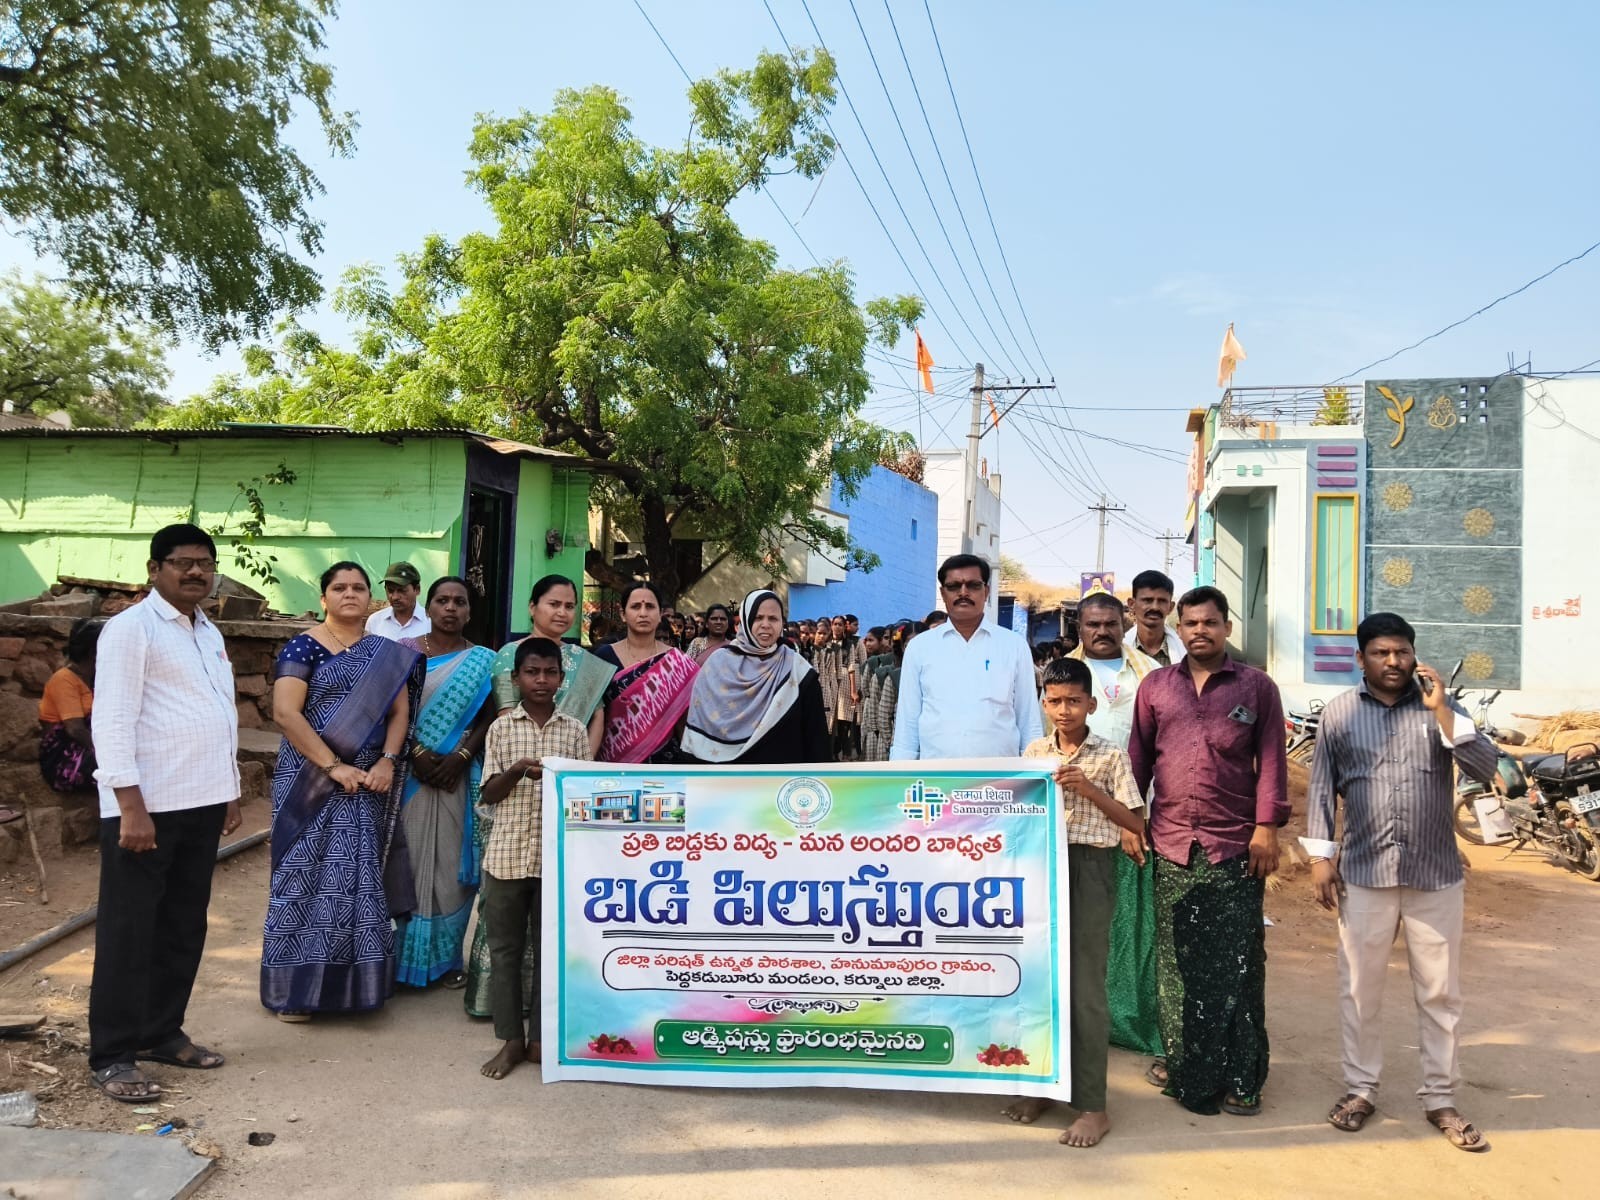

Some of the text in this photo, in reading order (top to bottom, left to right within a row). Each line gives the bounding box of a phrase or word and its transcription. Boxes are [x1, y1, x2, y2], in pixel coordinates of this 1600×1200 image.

[985, 787, 1012, 801] शिक्षा
[953, 804, 1046, 816] Samagra Shiksha
[621, 832, 660, 858] ప్రతి
[665, 832, 728, 861] బిడ్డకు
[733, 833, 778, 860] విద్య
[799, 832, 845, 852] మన
[850, 834, 921, 853] అందరి
[926, 834, 1002, 862] బాధ్యత
[583, 859, 1026, 948] బడి పిలుస్తుంది
[617, 954, 650, 969] జిల్లా
[654, 953, 705, 969] పరిషత్
[709, 955, 754, 972] ఉన్నత
[830, 957, 938, 974] హనుమాపురం
[940, 959, 996, 975] గ్రామం,
[665, 970, 764, 989] పెద్దకడుబూరు
[768, 972, 840, 987] మండలం,
[844, 973, 904, 991] కర్నూలు
